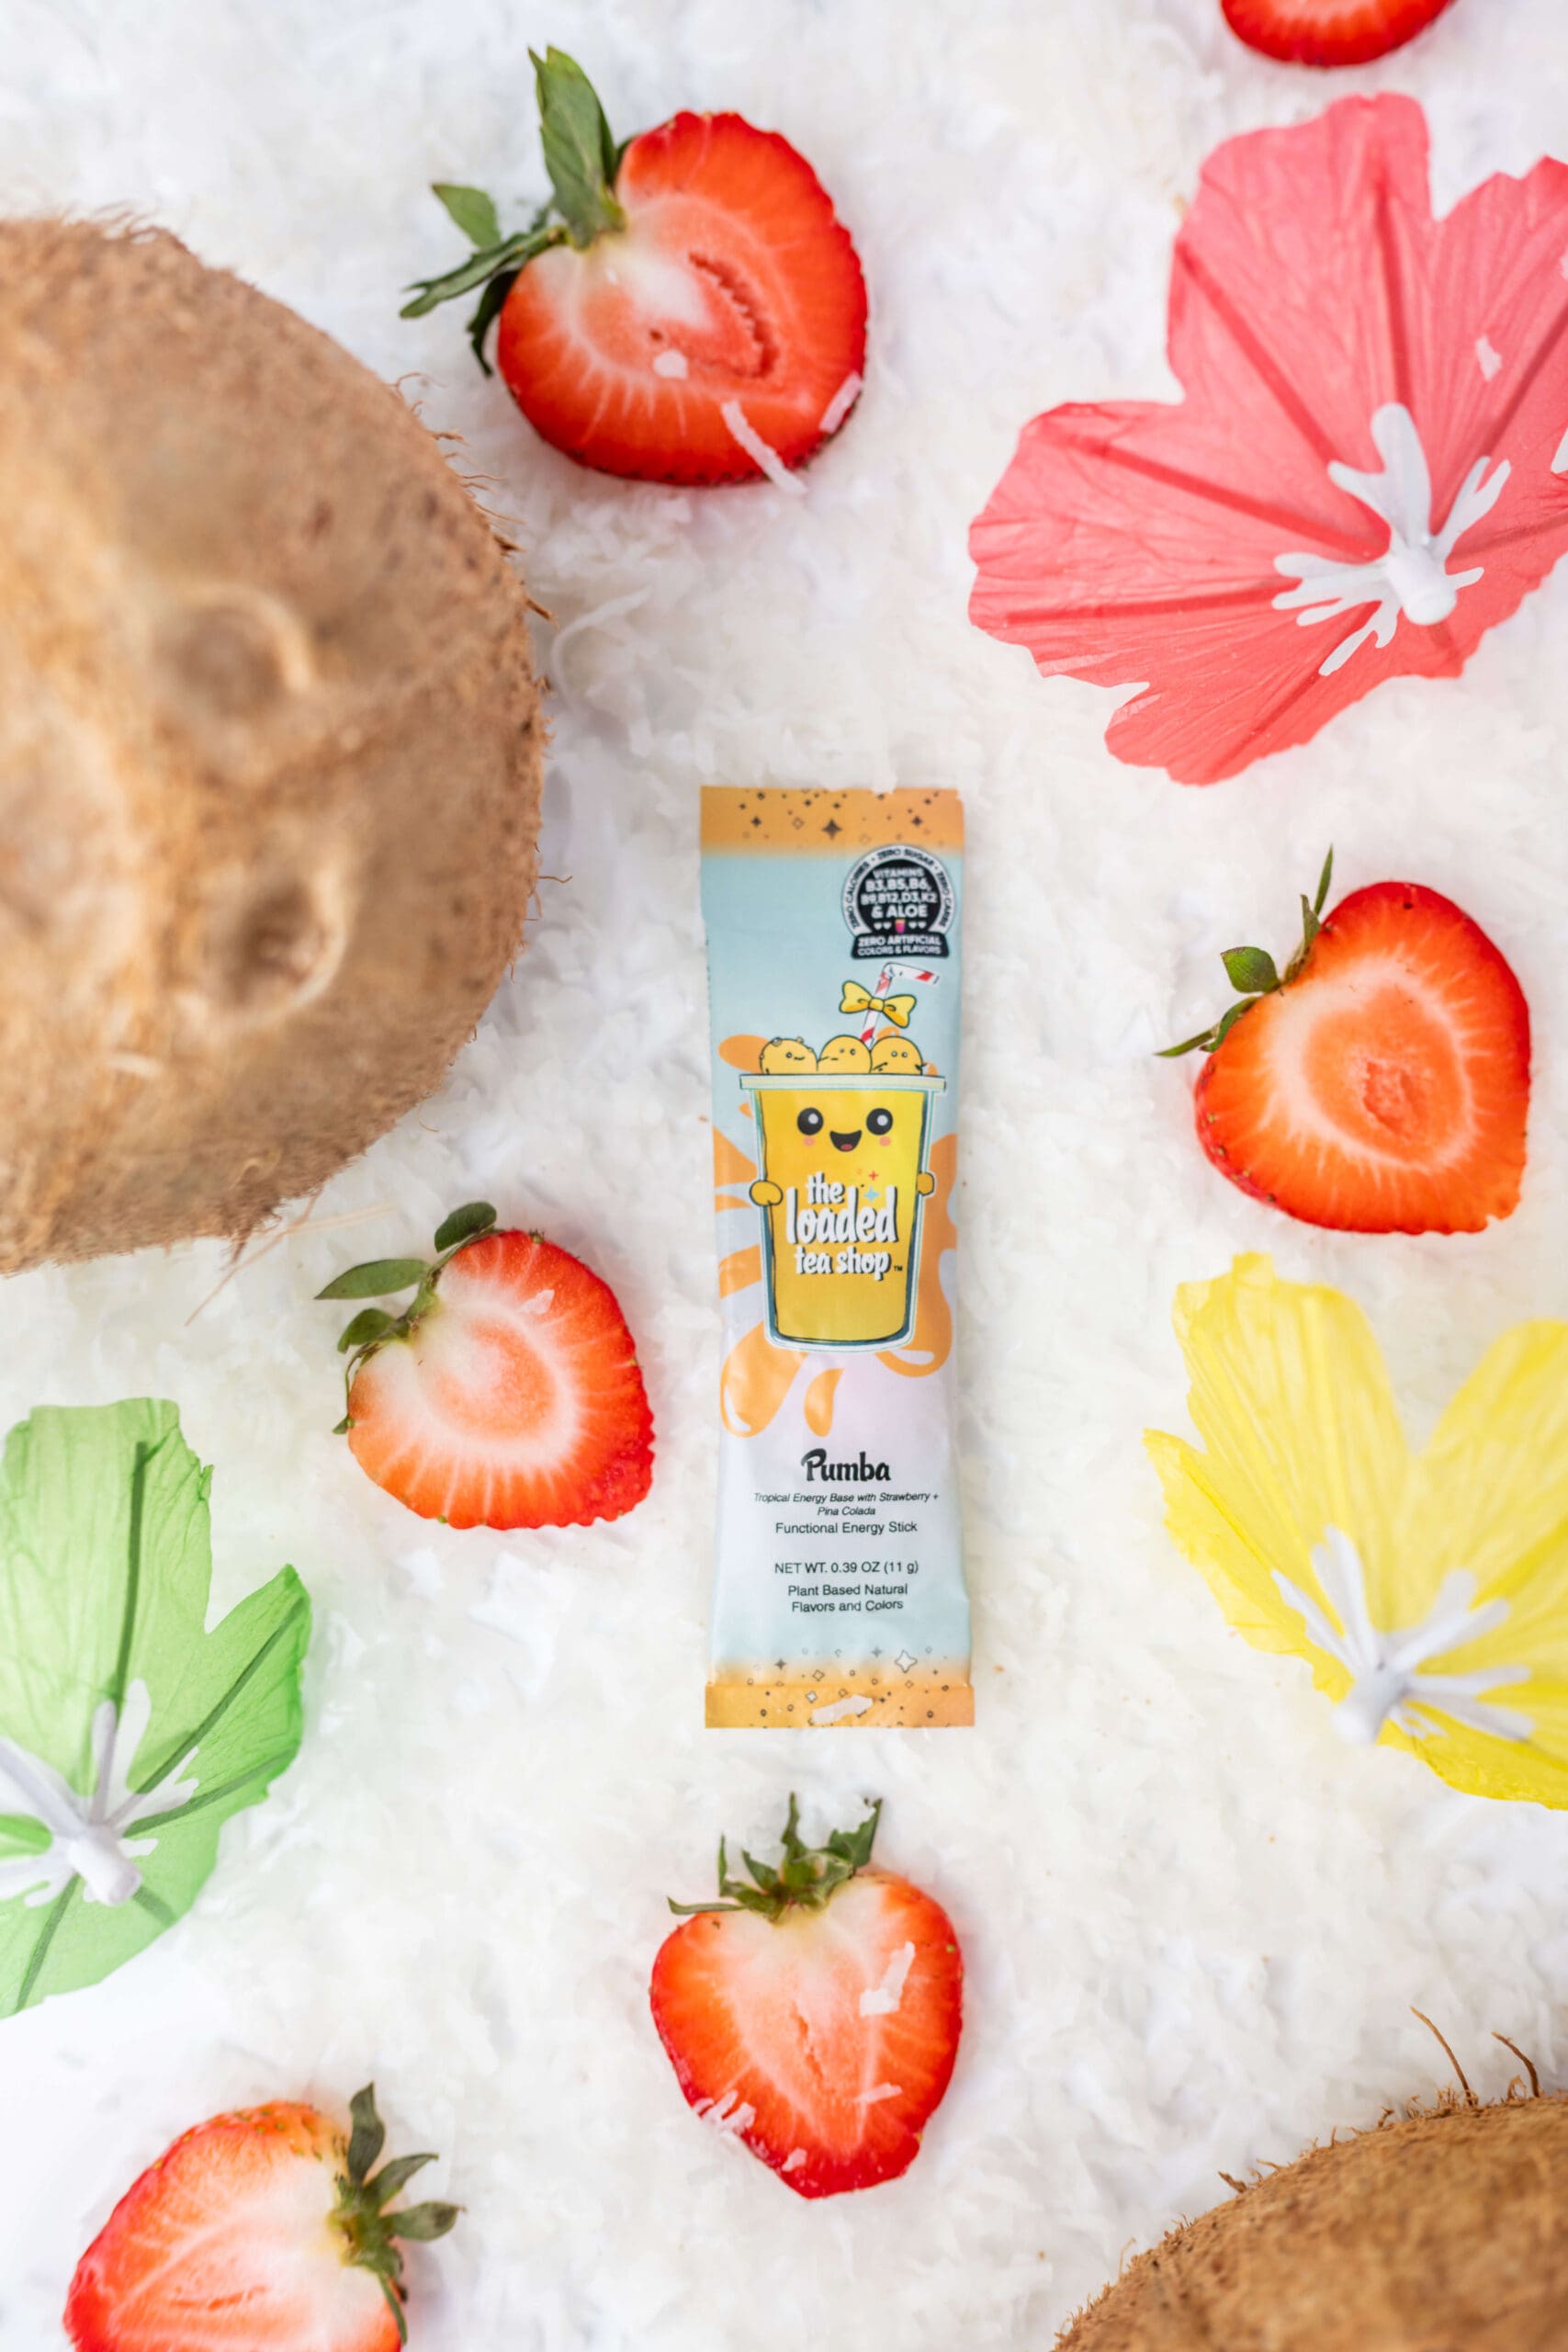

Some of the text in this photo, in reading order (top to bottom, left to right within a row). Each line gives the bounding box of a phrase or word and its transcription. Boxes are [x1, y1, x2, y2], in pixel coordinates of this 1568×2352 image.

[874, 868, 924, 879] VITAMINS
[871, 904, 928, 918] & ALOE
[858, 935, 942, 946] ZERO ARTIFICIAL
[858, 946, 894, 956] COLORS
[903, 944, 942, 955] FLAVORS
[806, 1171, 845, 1204] the
[786, 1185, 898, 1244] loaded
[795, 1245, 833, 1274] tea
[836, 1245, 891, 1281] shop
[800, 1448, 892, 1482] Pumba
[754, 1492, 790, 1503] Tropical
[793, 1493, 827, 1504] Energy
[829, 1493, 854, 1502] Base
[857, 1493, 876, 1502] with
[879, 1492, 931, 1503] Strawberry
[818, 1506, 876, 1516] Pina Colada
[775, 1521, 918, 1535] Functional Energy Stick
[774, 1560, 919, 1575] NET WT. 0.39 OZ (11 g)
[788, 1583, 908, 1597] Plant Based Natural
[792, 1600, 903, 1612] Flavors and Colors
